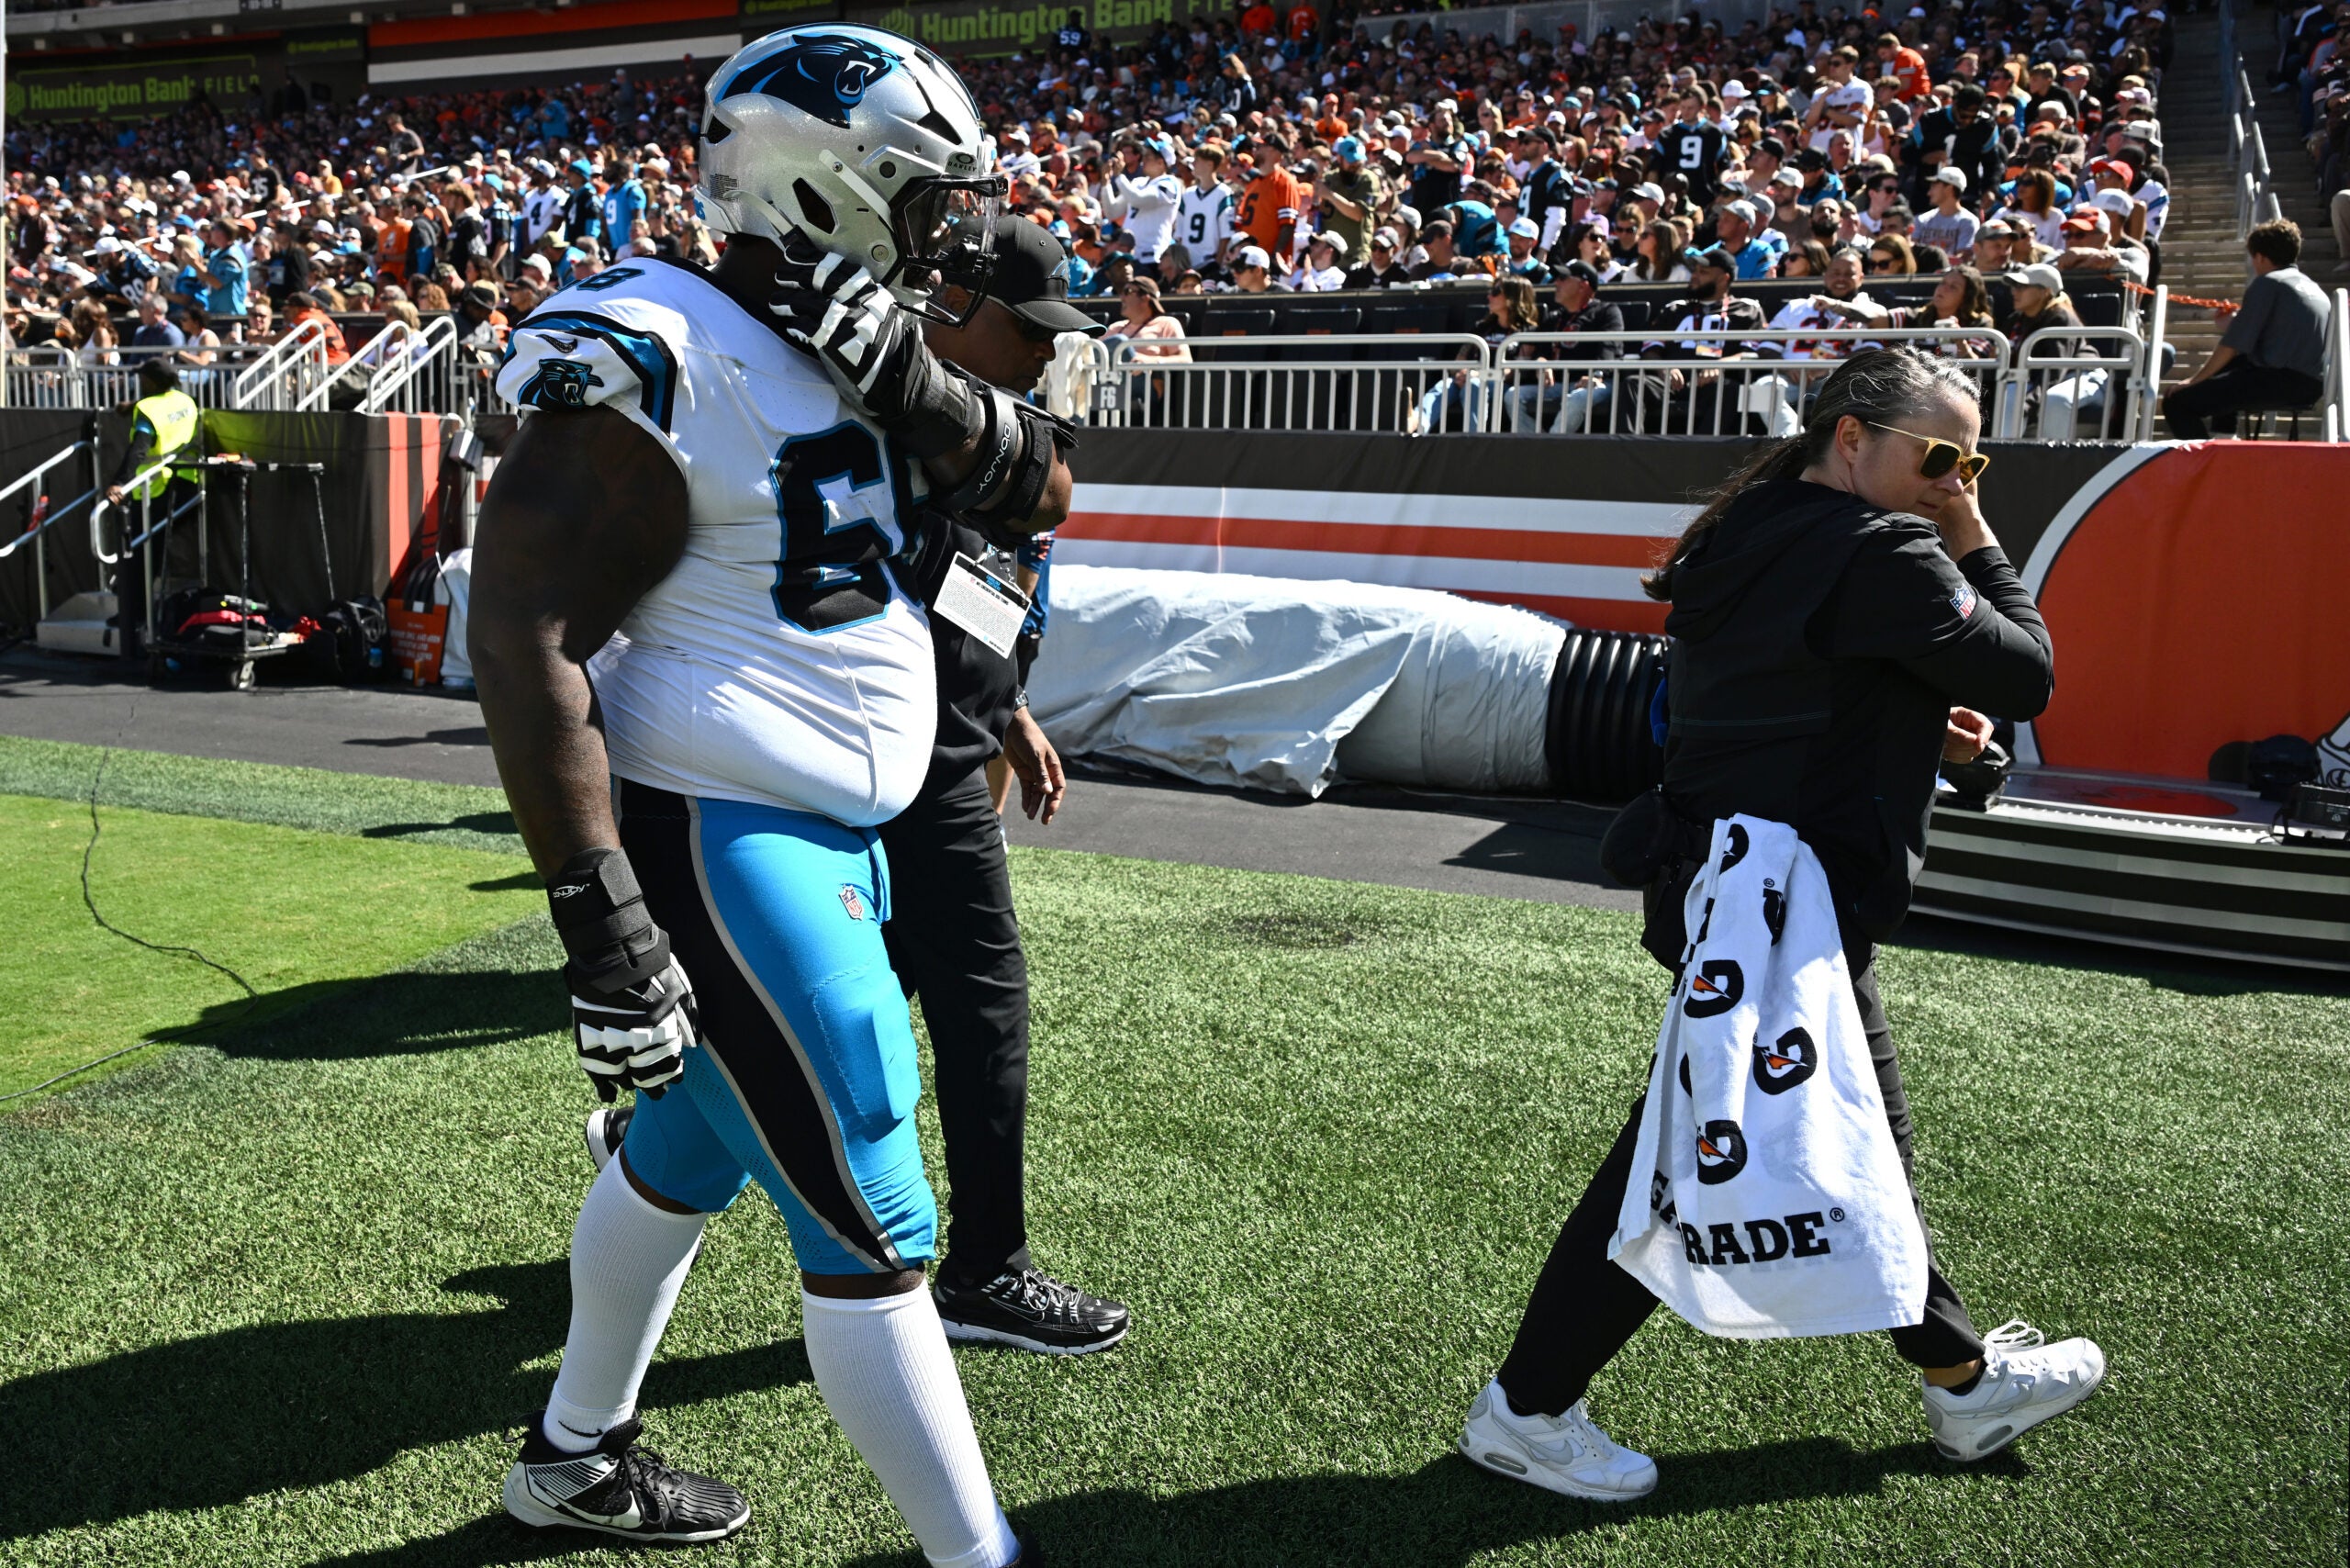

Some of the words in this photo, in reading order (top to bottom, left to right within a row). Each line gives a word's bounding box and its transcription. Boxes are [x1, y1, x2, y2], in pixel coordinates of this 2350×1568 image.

[921, 4, 1086, 44] Huntington
[1059, 30, 1081, 46] 59
[28, 81, 141, 113] Huntington
[1679, 135, 1703, 169] 9
[947, 161, 977, 173] OAKLEY
[531, 201, 543, 226] 4
[606, 198, 618, 225] 9
[1517, 185, 1532, 219] 9
[1188, 213, 1206, 244] 9
[1100, 386, 1117, 409] F6
